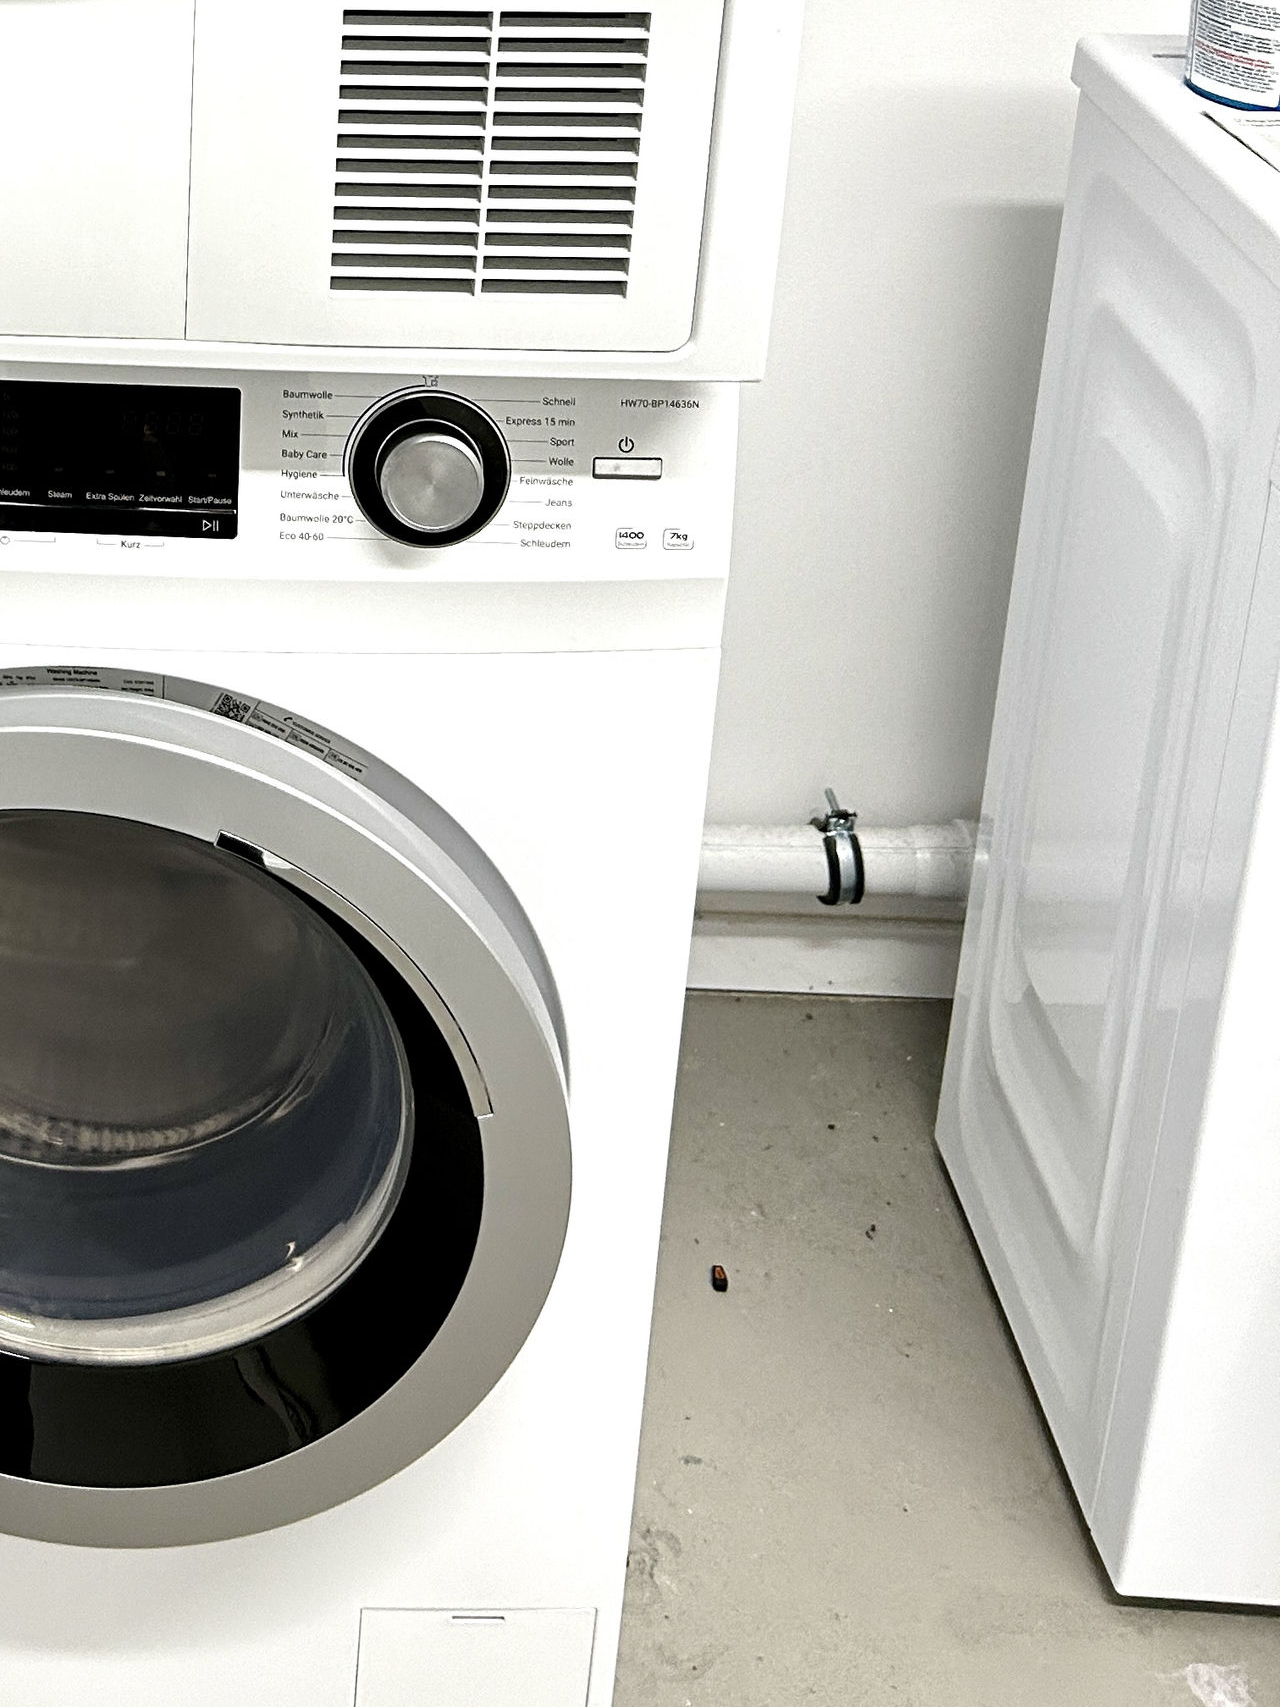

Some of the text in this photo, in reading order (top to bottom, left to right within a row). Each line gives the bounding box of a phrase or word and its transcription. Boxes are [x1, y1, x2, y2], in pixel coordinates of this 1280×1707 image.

[282, 390, 333, 400] Baumwolle
[542, 397, 576, 407] Schnell
[620, 399, 699, 409] HW70-BP14636N
[282, 410, 324, 420] Synthetik
[506, 417, 575, 427] Express 15 min
[282, 430, 298, 438] Mix
[550, 437, 575, 447] Sport
[281, 450, 328, 460] Baby Care
[549, 457, 574, 467] Wolle
[281, 470, 318, 480] Hygiene
[519, 477, 573, 486] Feinwäsche
[48, 490, 73, 499] Steam
[86, 492, 106, 501] Extra
[138, 494, 183, 503] Zeitvorwahl
[281, 491, 340, 500] Unterwäsche
[188, 495, 232, 505] Start/Pause
[545, 499, 573, 508] Jeans
[280, 513, 354, 524] Baumwolle 20°C
[513, 521, 571, 531] Steppdecken
[279, 531, 324, 541] Eco 40-60
[670, 532, 688, 541] 7kg
[121, 540, 141, 548] Kurz
[520, 540, 571, 548] Schleudern
